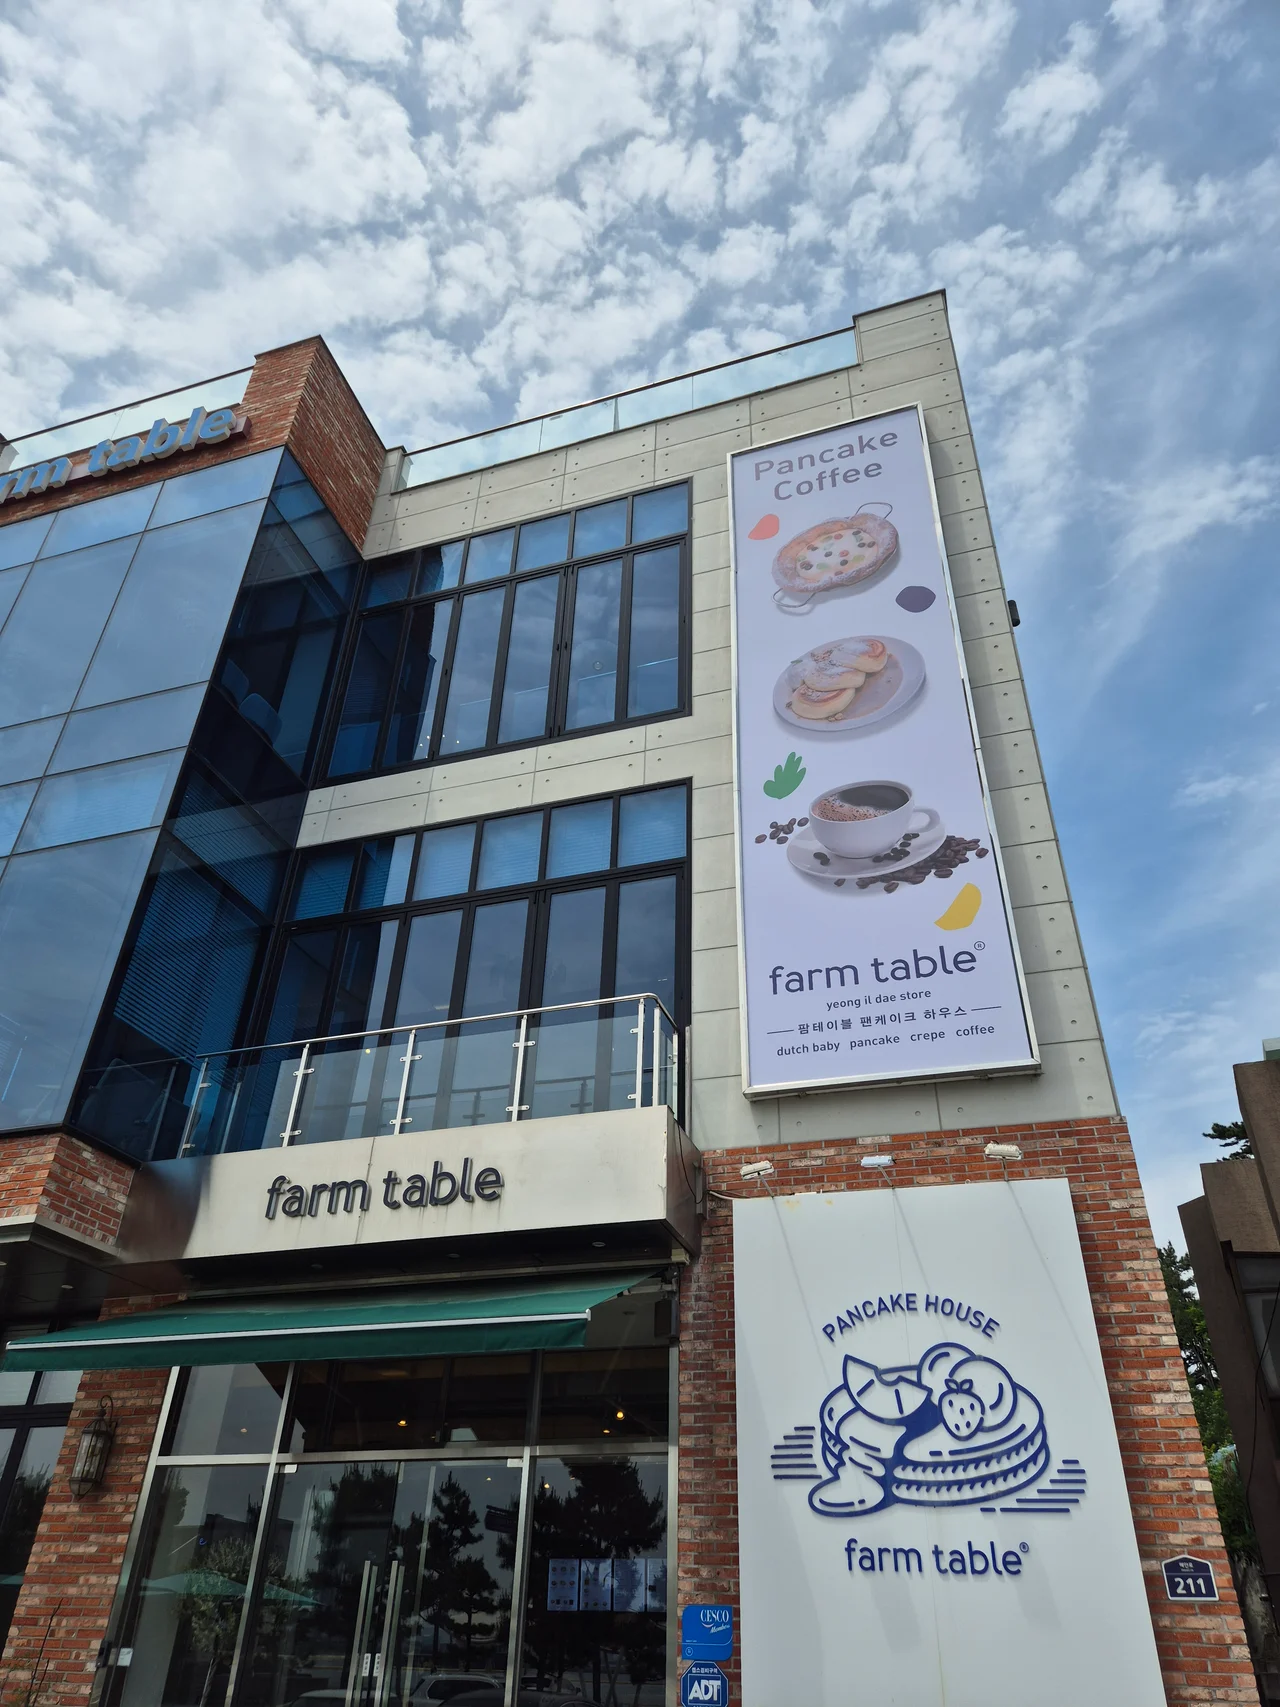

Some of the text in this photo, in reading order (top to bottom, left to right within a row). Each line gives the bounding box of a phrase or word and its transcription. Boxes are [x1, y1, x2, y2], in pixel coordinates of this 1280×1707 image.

[87, 406, 238, 478] table
[754, 431, 899, 481] Pancake
[773, 462, 883, 500] Coffee
[769, 965, 860, 995] farm
[826, 990, 932, 1011] yeong il dae store
[797, 1006, 968, 1035] 팜테이블 팬케이크 하우스
[776, 1024, 995, 1056] dutch baby pancake crepe coffee
[265, 1156, 504, 1220] farm table
[822, 1293, 1001, 1343] PANCAKE HOUSE
[844, 1538, 923, 1573] farm
[1174, 1577, 1206, 1595] 211
[700, 1609, 730, 1623] CESCO
[688, 1679, 722, 1701] ADT
